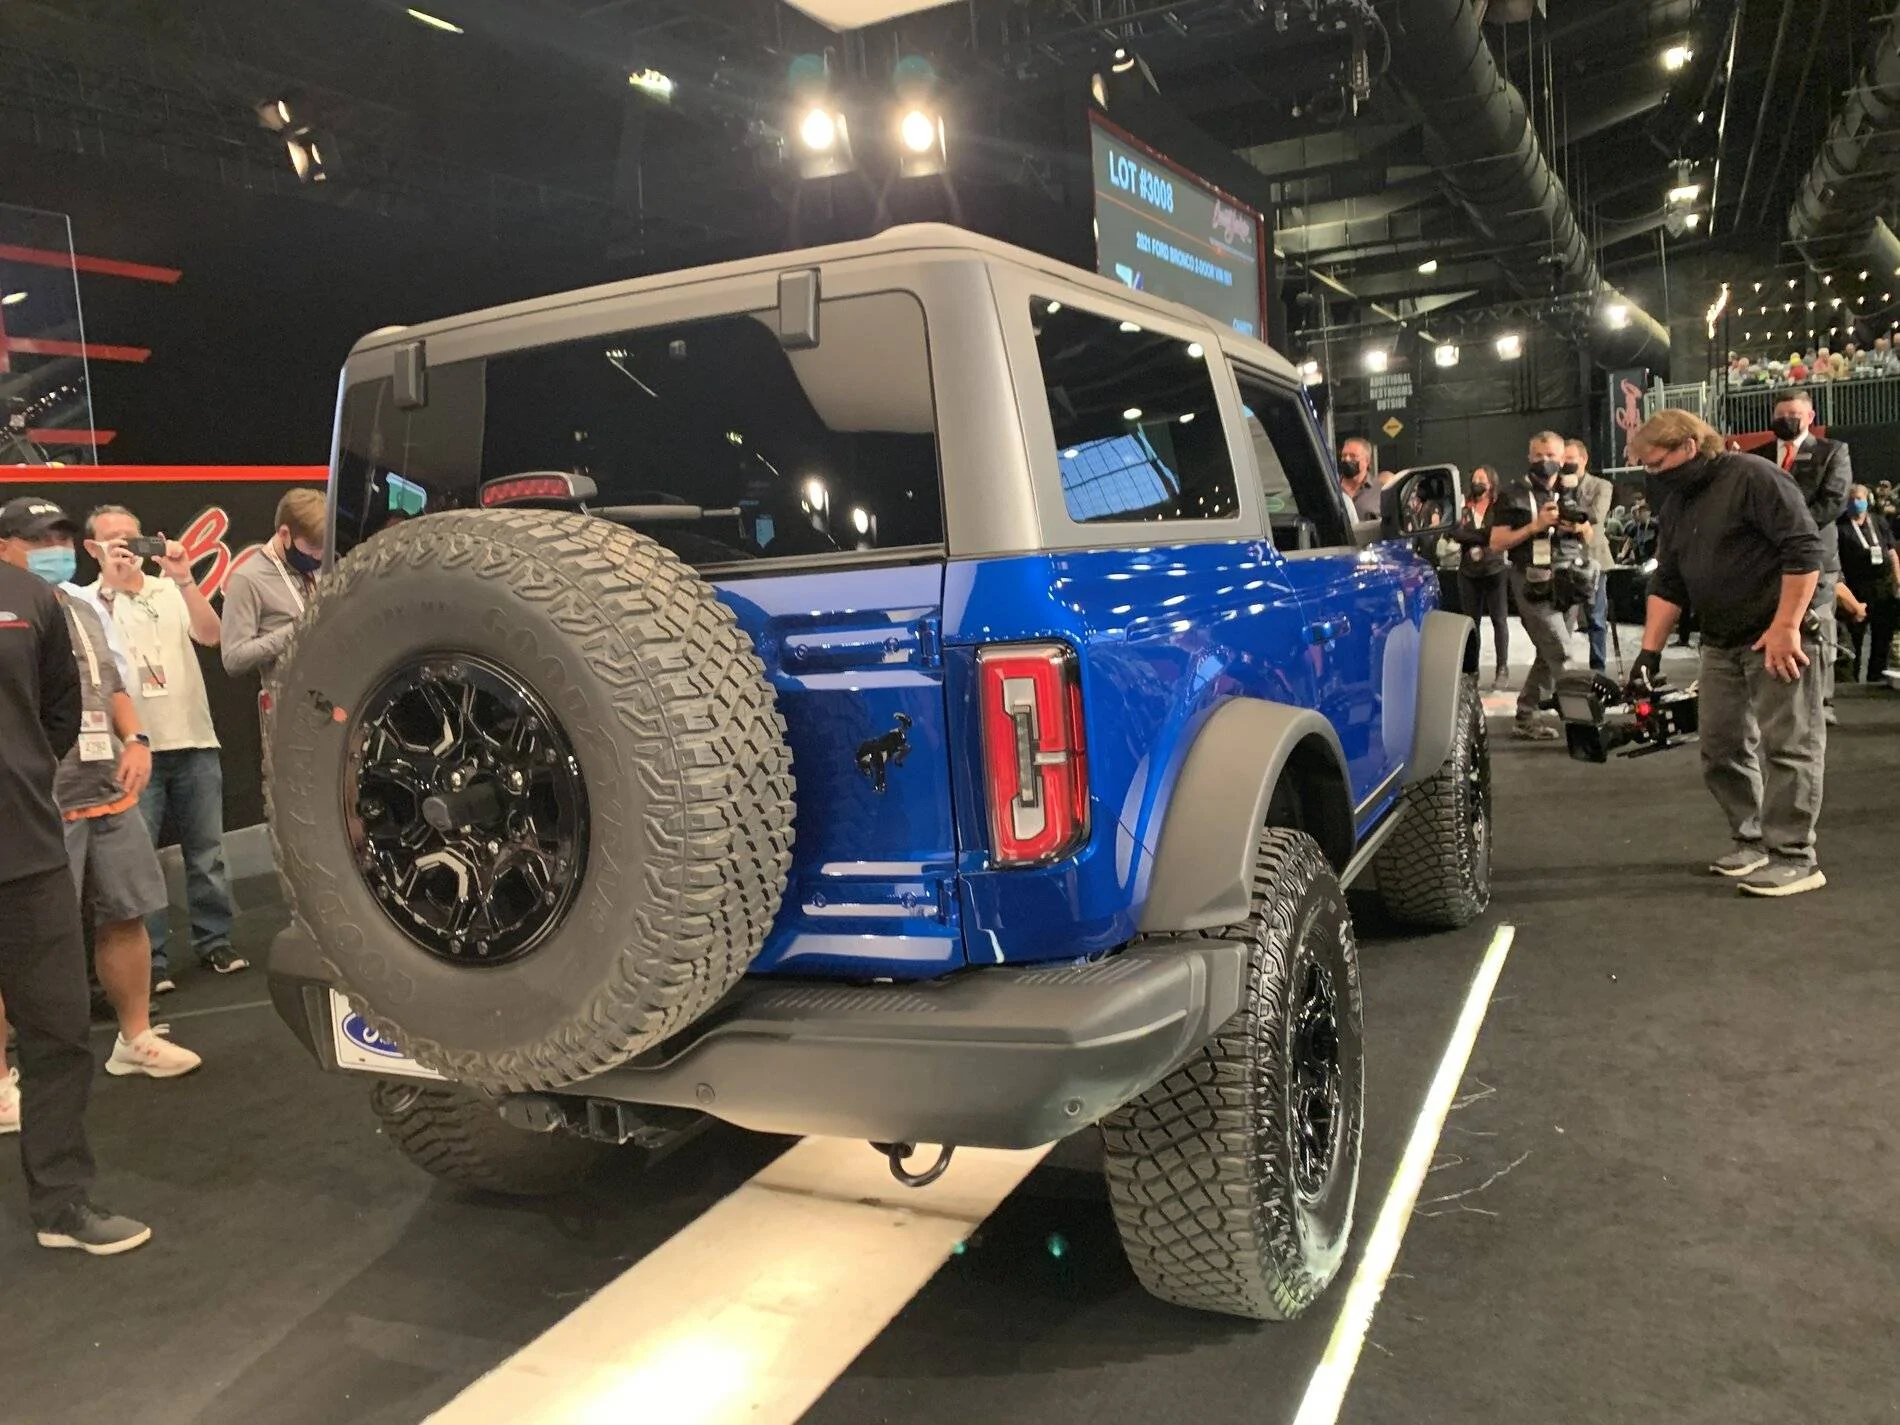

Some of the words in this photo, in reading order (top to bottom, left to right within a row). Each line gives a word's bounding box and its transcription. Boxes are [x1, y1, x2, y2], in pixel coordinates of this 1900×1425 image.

[1109, 150, 1137, 194] LOT
[1140, 167, 1174, 213] #3008
[1152, 238, 1170, 262] FORD
[1370, 373, 1411, 387] ADDITIONAL
[1370, 384, 1413, 400] RESTROOMS
[1377, 397, 1407, 411] OUTSIDE
